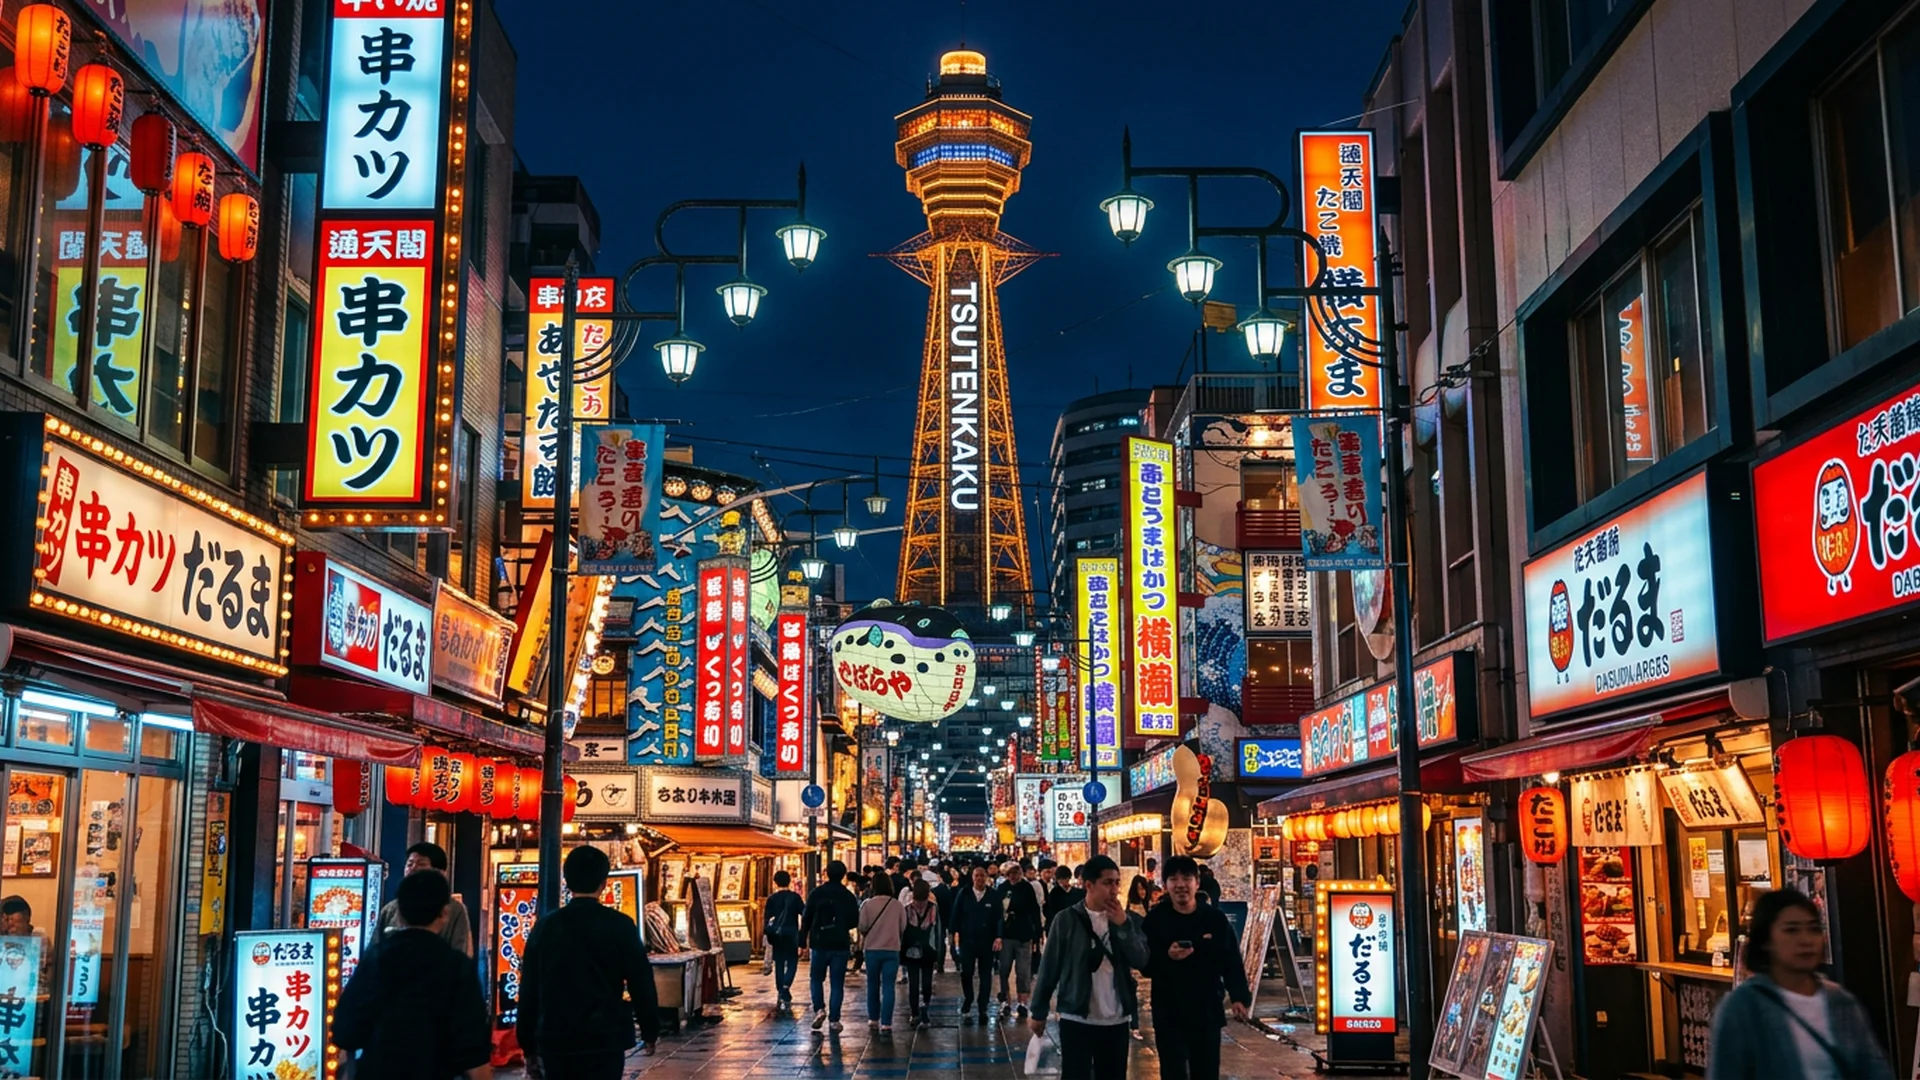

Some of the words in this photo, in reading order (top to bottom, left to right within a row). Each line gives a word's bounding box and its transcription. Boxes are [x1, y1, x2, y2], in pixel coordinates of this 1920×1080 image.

[353, 26, 416, 200] 串カツ
[331, 276, 408, 489] 串カツ
[950, 281, 978, 511] TSUTENKAKU
[75, 490, 176, 593] 串カツ
[182, 530, 272, 639] だるま
[1577, 541, 1665, 668] だるま
[383, 608, 426, 683] だるま
[273, 942, 314, 960] だるま
[286, 970, 312, 1058] 串カツ
[1349, 933, 1376, 1012] だるま
